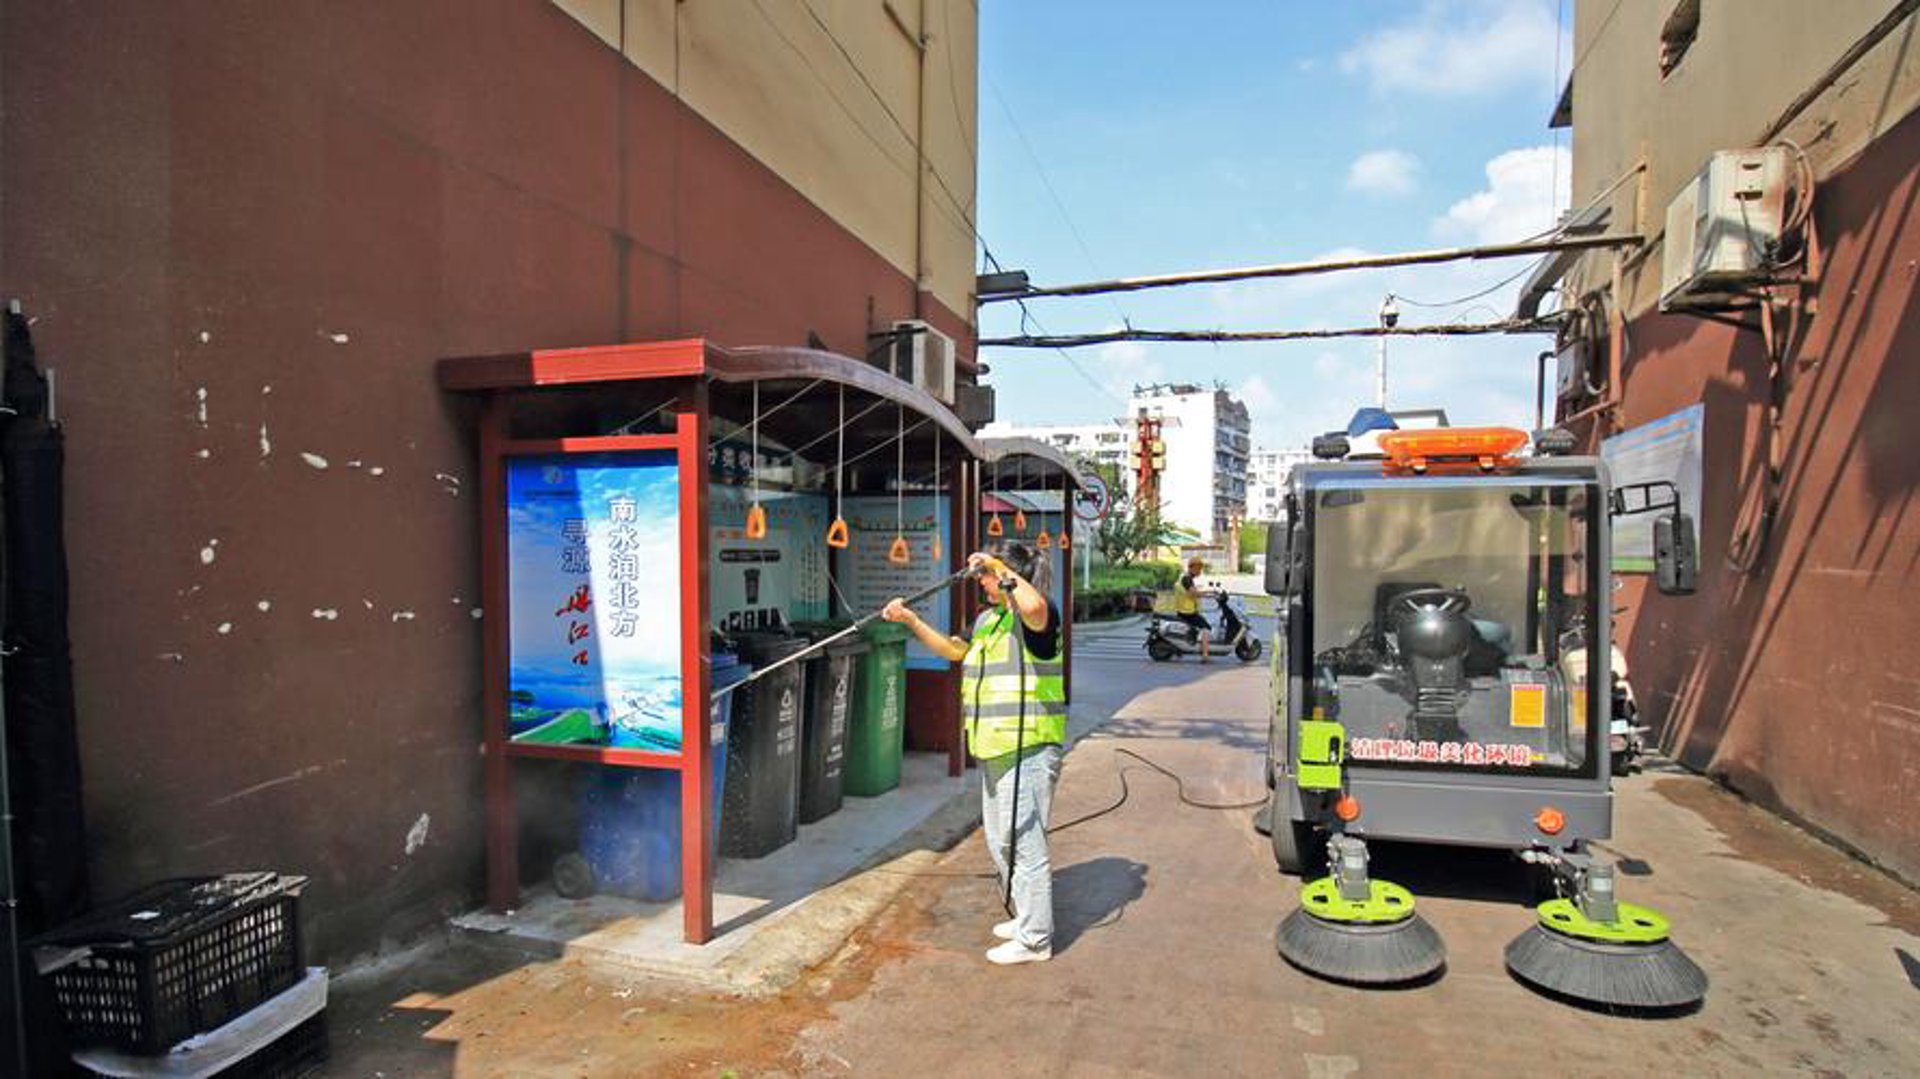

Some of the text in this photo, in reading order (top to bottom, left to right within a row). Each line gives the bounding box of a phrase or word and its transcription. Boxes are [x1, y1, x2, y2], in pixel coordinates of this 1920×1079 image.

[608, 494, 640, 638] 南水润北方
